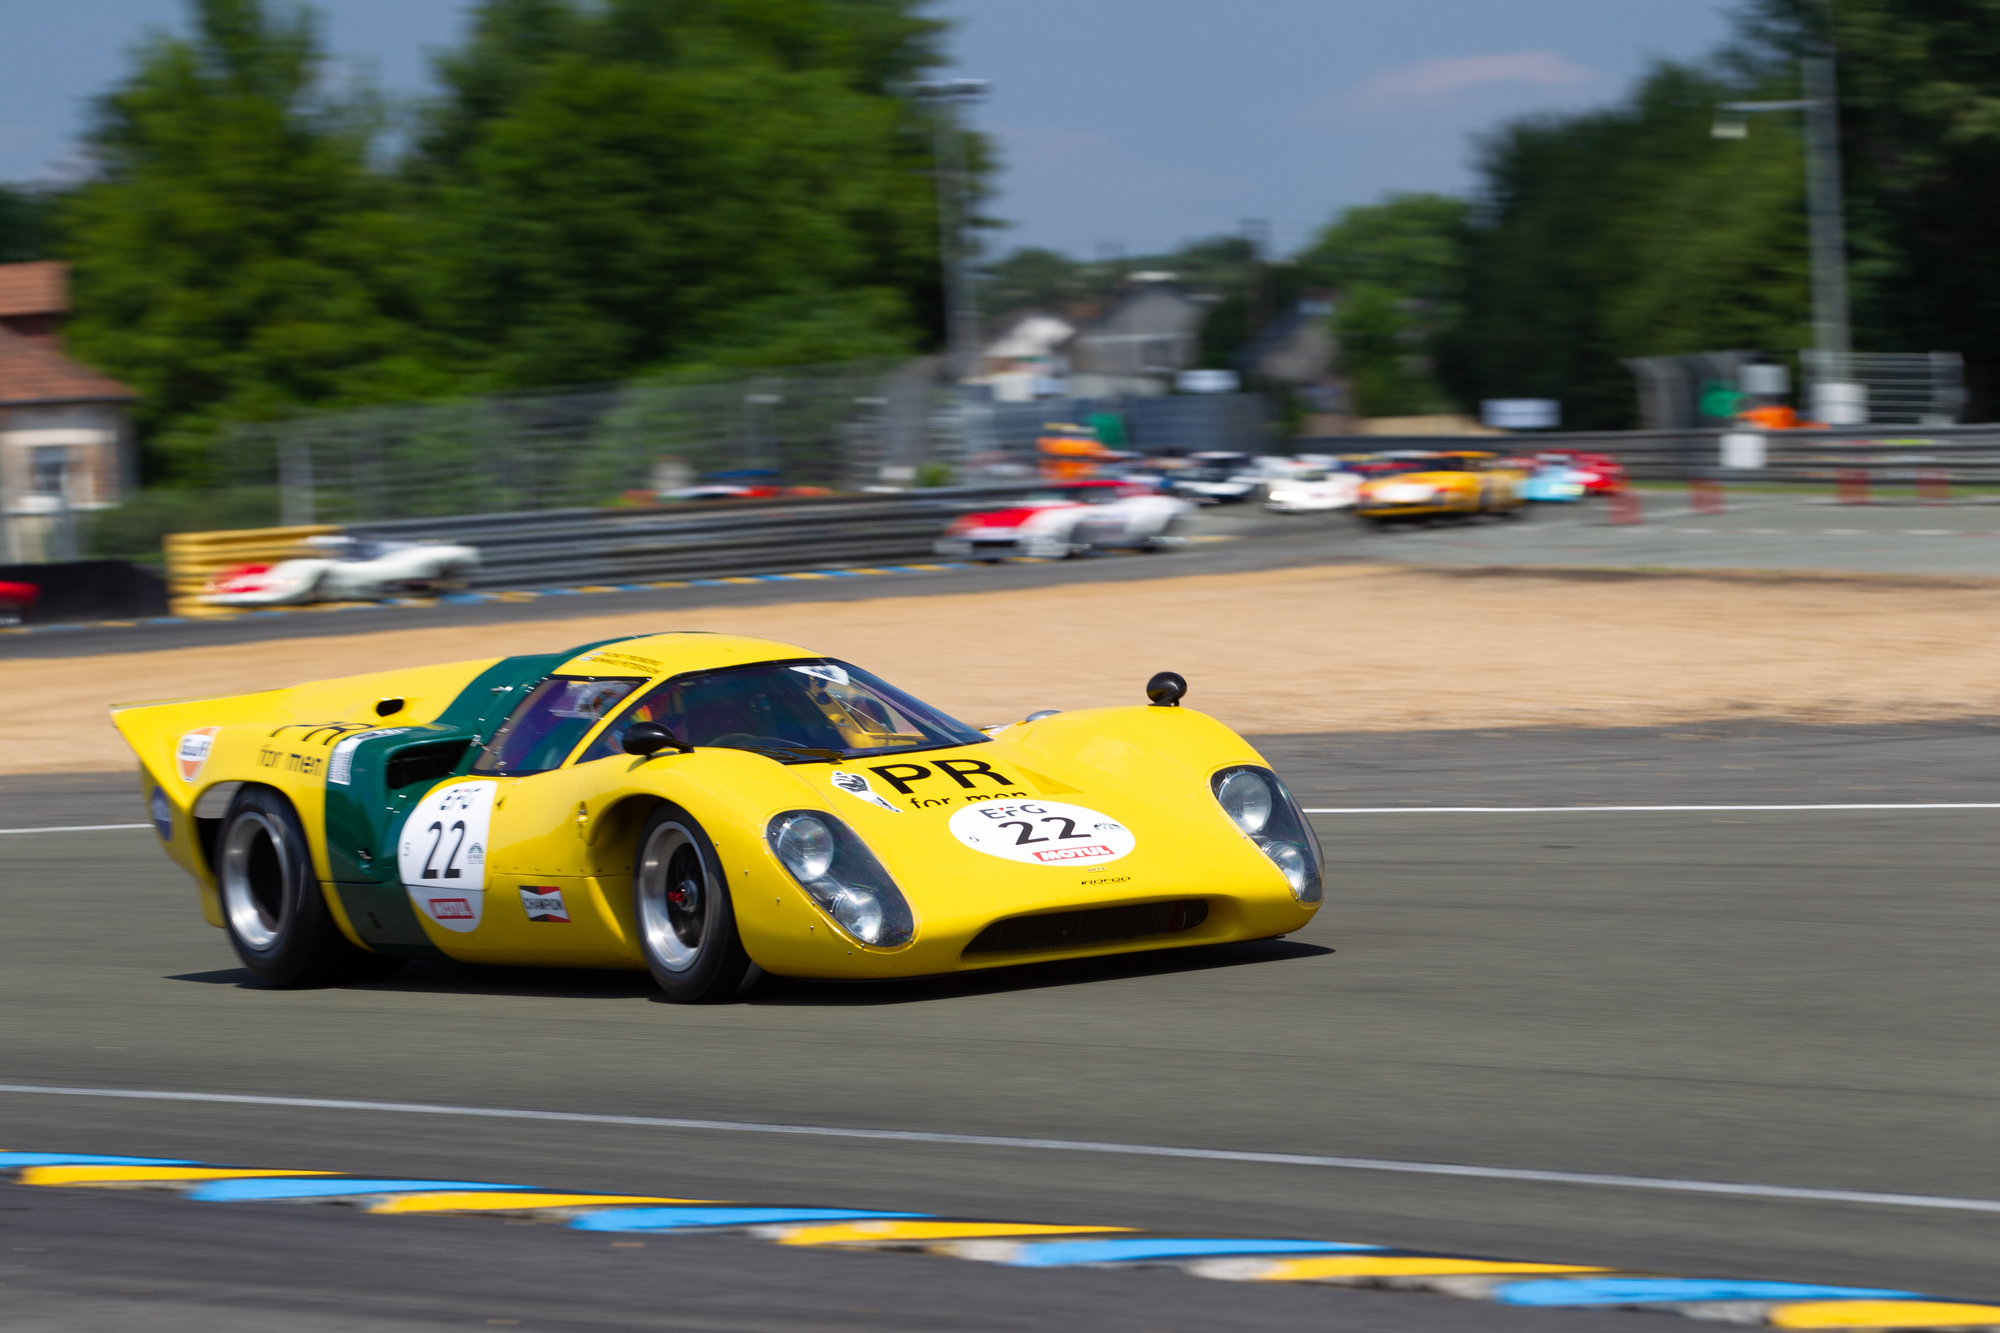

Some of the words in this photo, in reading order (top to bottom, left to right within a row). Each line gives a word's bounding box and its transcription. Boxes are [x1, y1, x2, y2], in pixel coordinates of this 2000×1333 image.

[867, 759, 1015, 795] PR
[978, 804, 1048, 820] EFG
[997, 816, 1093, 846] 22
[421, 820, 466, 880] 22
[1040, 845, 1111, 861] MOTUL
[522, 897, 565, 911] CHAMPION
